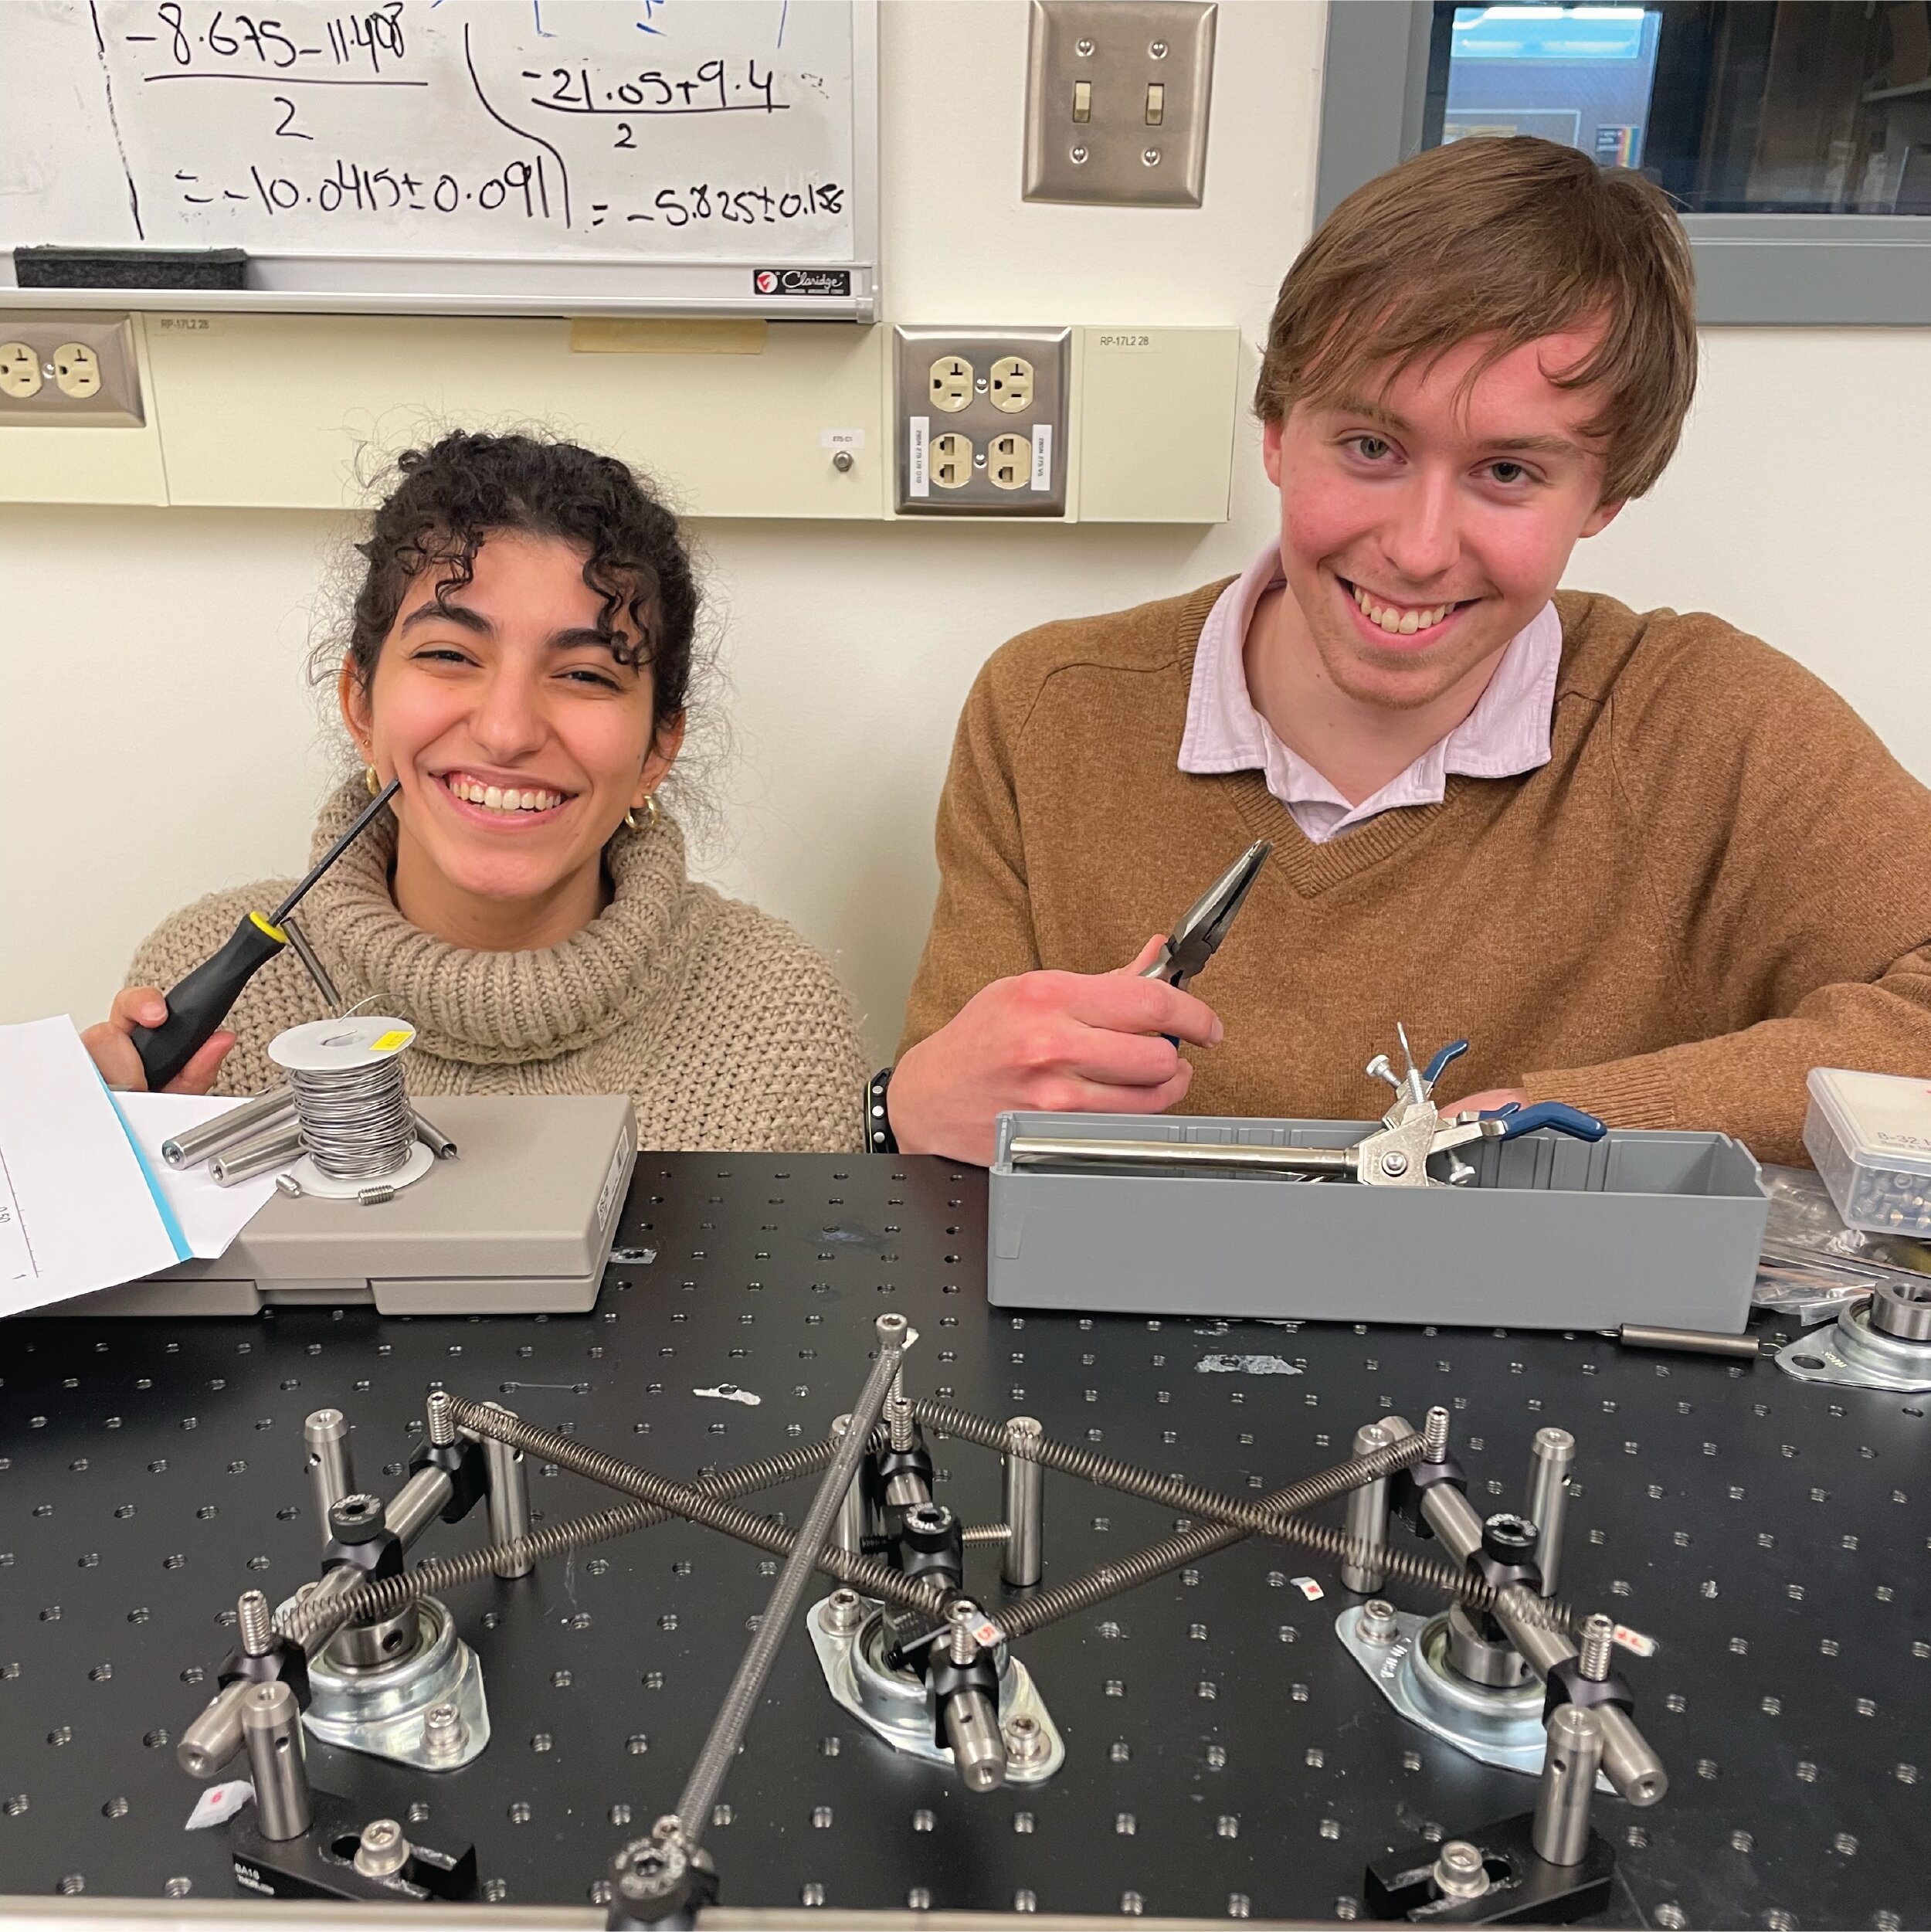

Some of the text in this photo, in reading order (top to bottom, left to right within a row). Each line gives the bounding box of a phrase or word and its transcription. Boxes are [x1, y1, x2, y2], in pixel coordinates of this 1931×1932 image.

[273, 97, 314, 140] 2
[614, 123, 637, 149] 2
[781, 270, 843, 290] Claridge
[1100, 336, 1136, 346] RP-17L2
